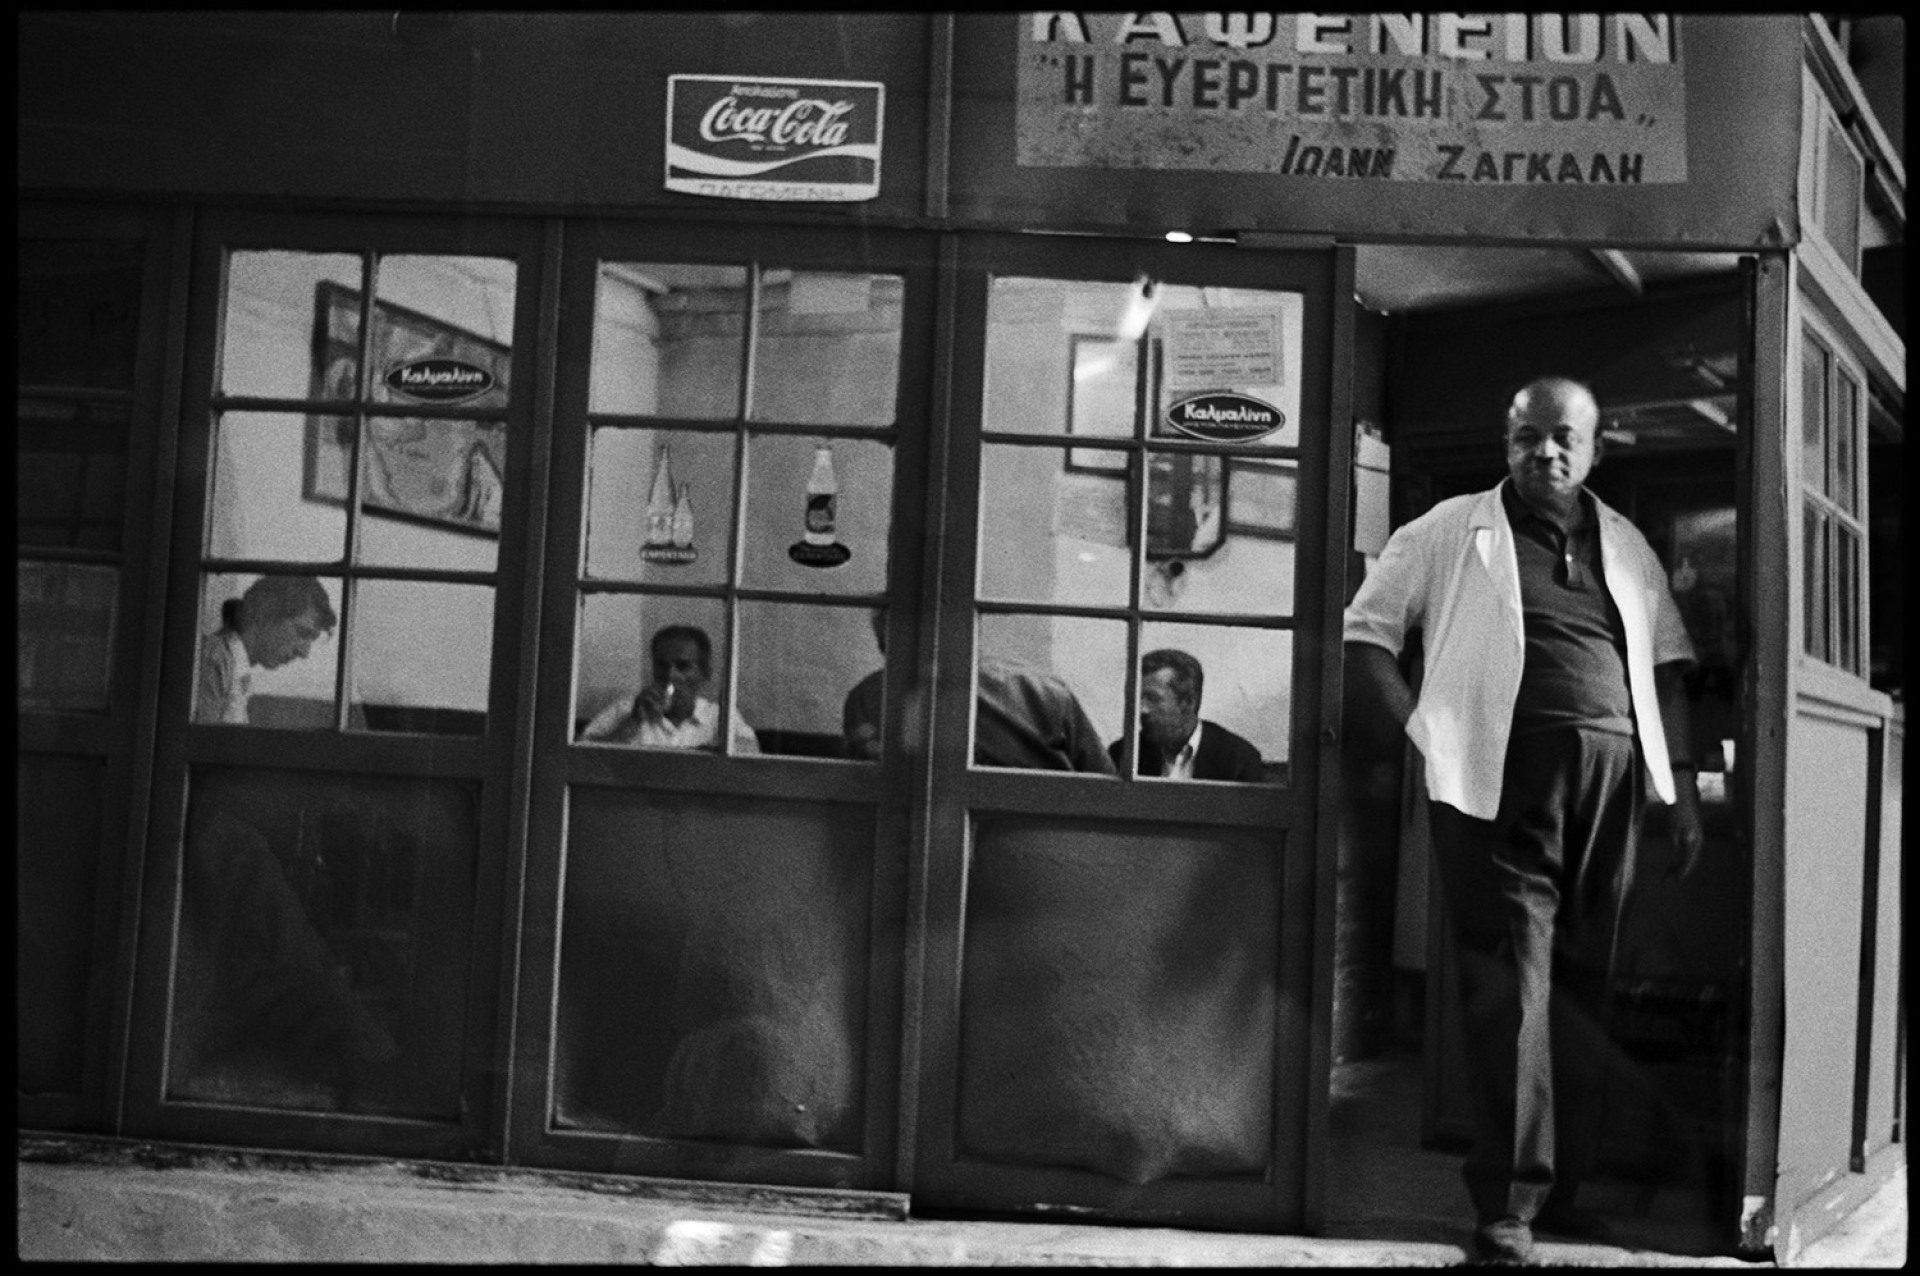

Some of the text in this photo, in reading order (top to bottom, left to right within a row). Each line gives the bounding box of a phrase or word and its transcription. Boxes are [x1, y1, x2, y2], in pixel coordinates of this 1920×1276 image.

[1120, 52, 1441, 118] ΕΥΕΡΓΕΤΙΚΗ
[700, 96, 854, 146] Coca-Cola
[1436, 145, 1643, 184] ΖΑΓΚΑΛΗ
